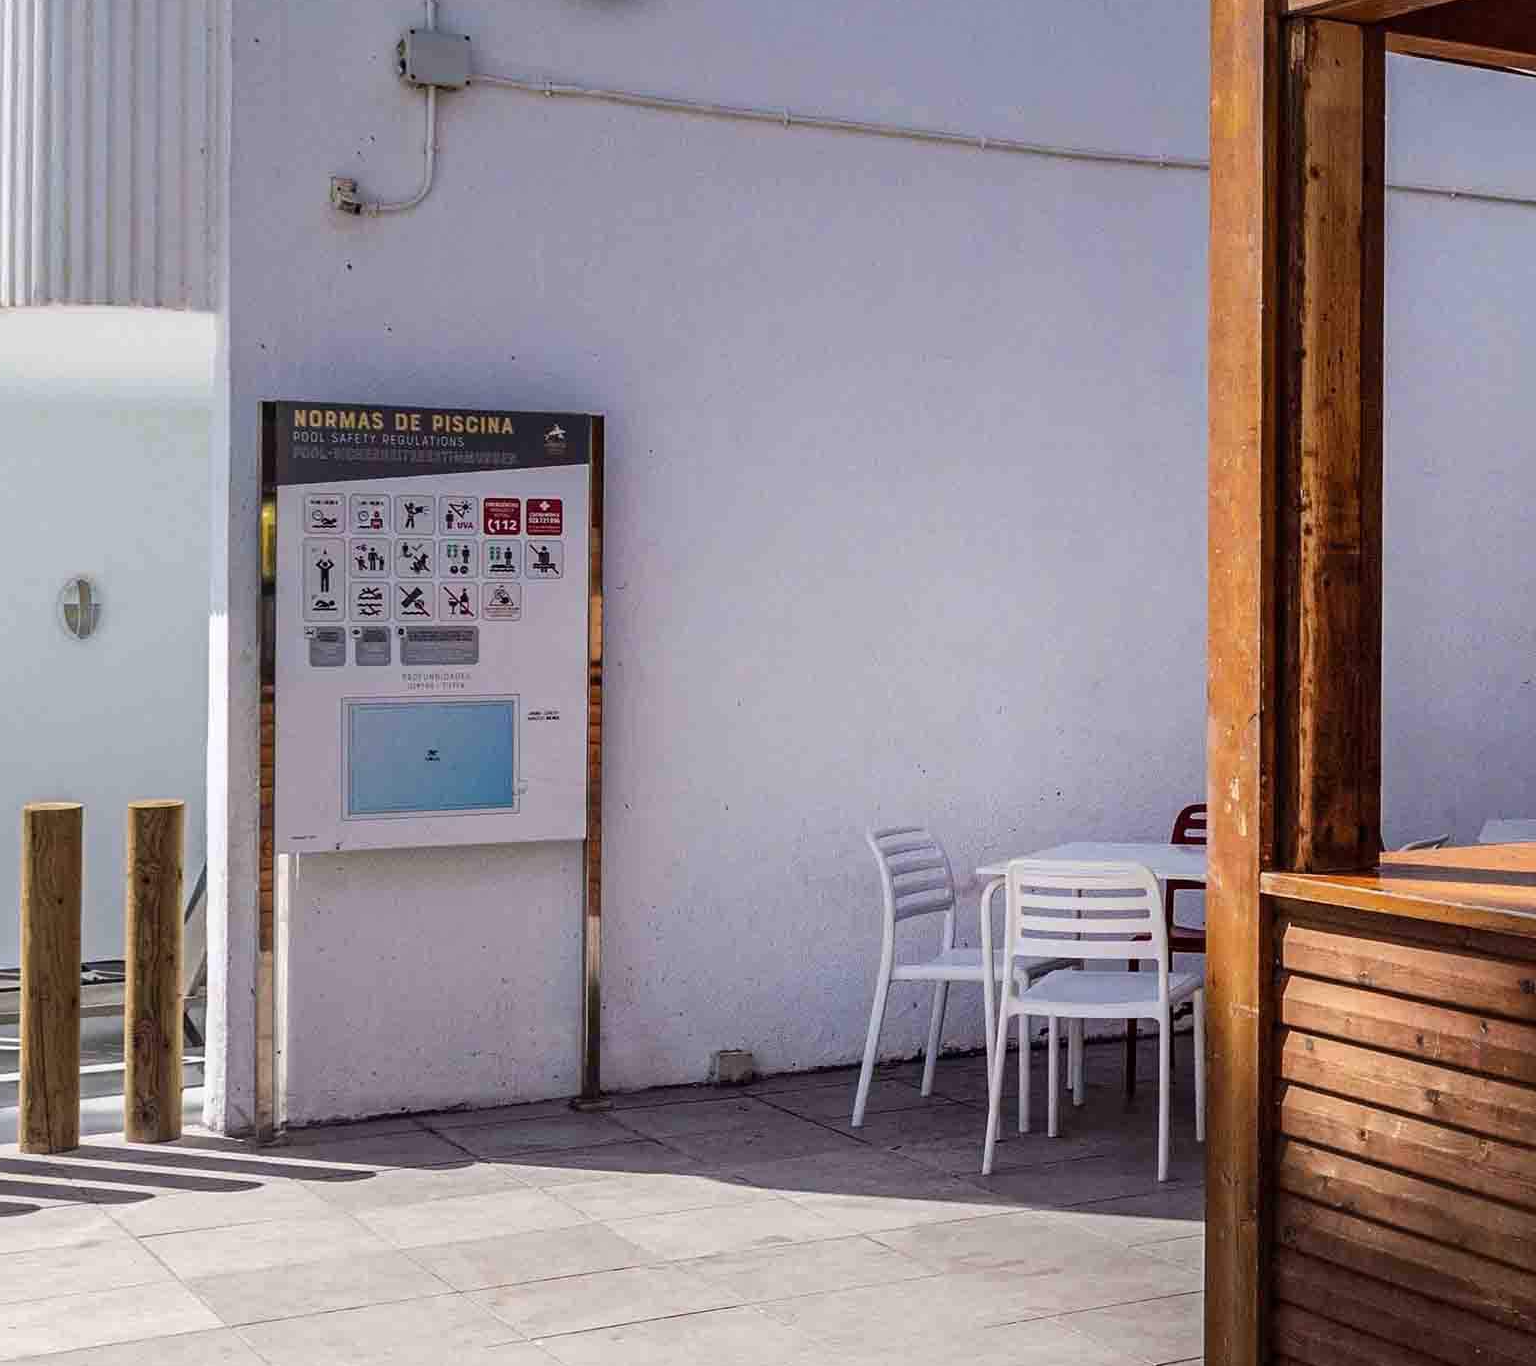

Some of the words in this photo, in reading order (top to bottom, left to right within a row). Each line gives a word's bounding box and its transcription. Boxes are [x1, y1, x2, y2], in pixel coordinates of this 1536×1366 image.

[293, 409, 384, 431] NORMAS
[395, 413, 422, 432] DE
[432, 415, 514, 435] PISCINA
[292, 431, 326, 444] POOL
[330, 432, 377, 446] SAFETY
[382, 434, 465, 449] REGULATIONS
[494, 519, 517, 531] 112
